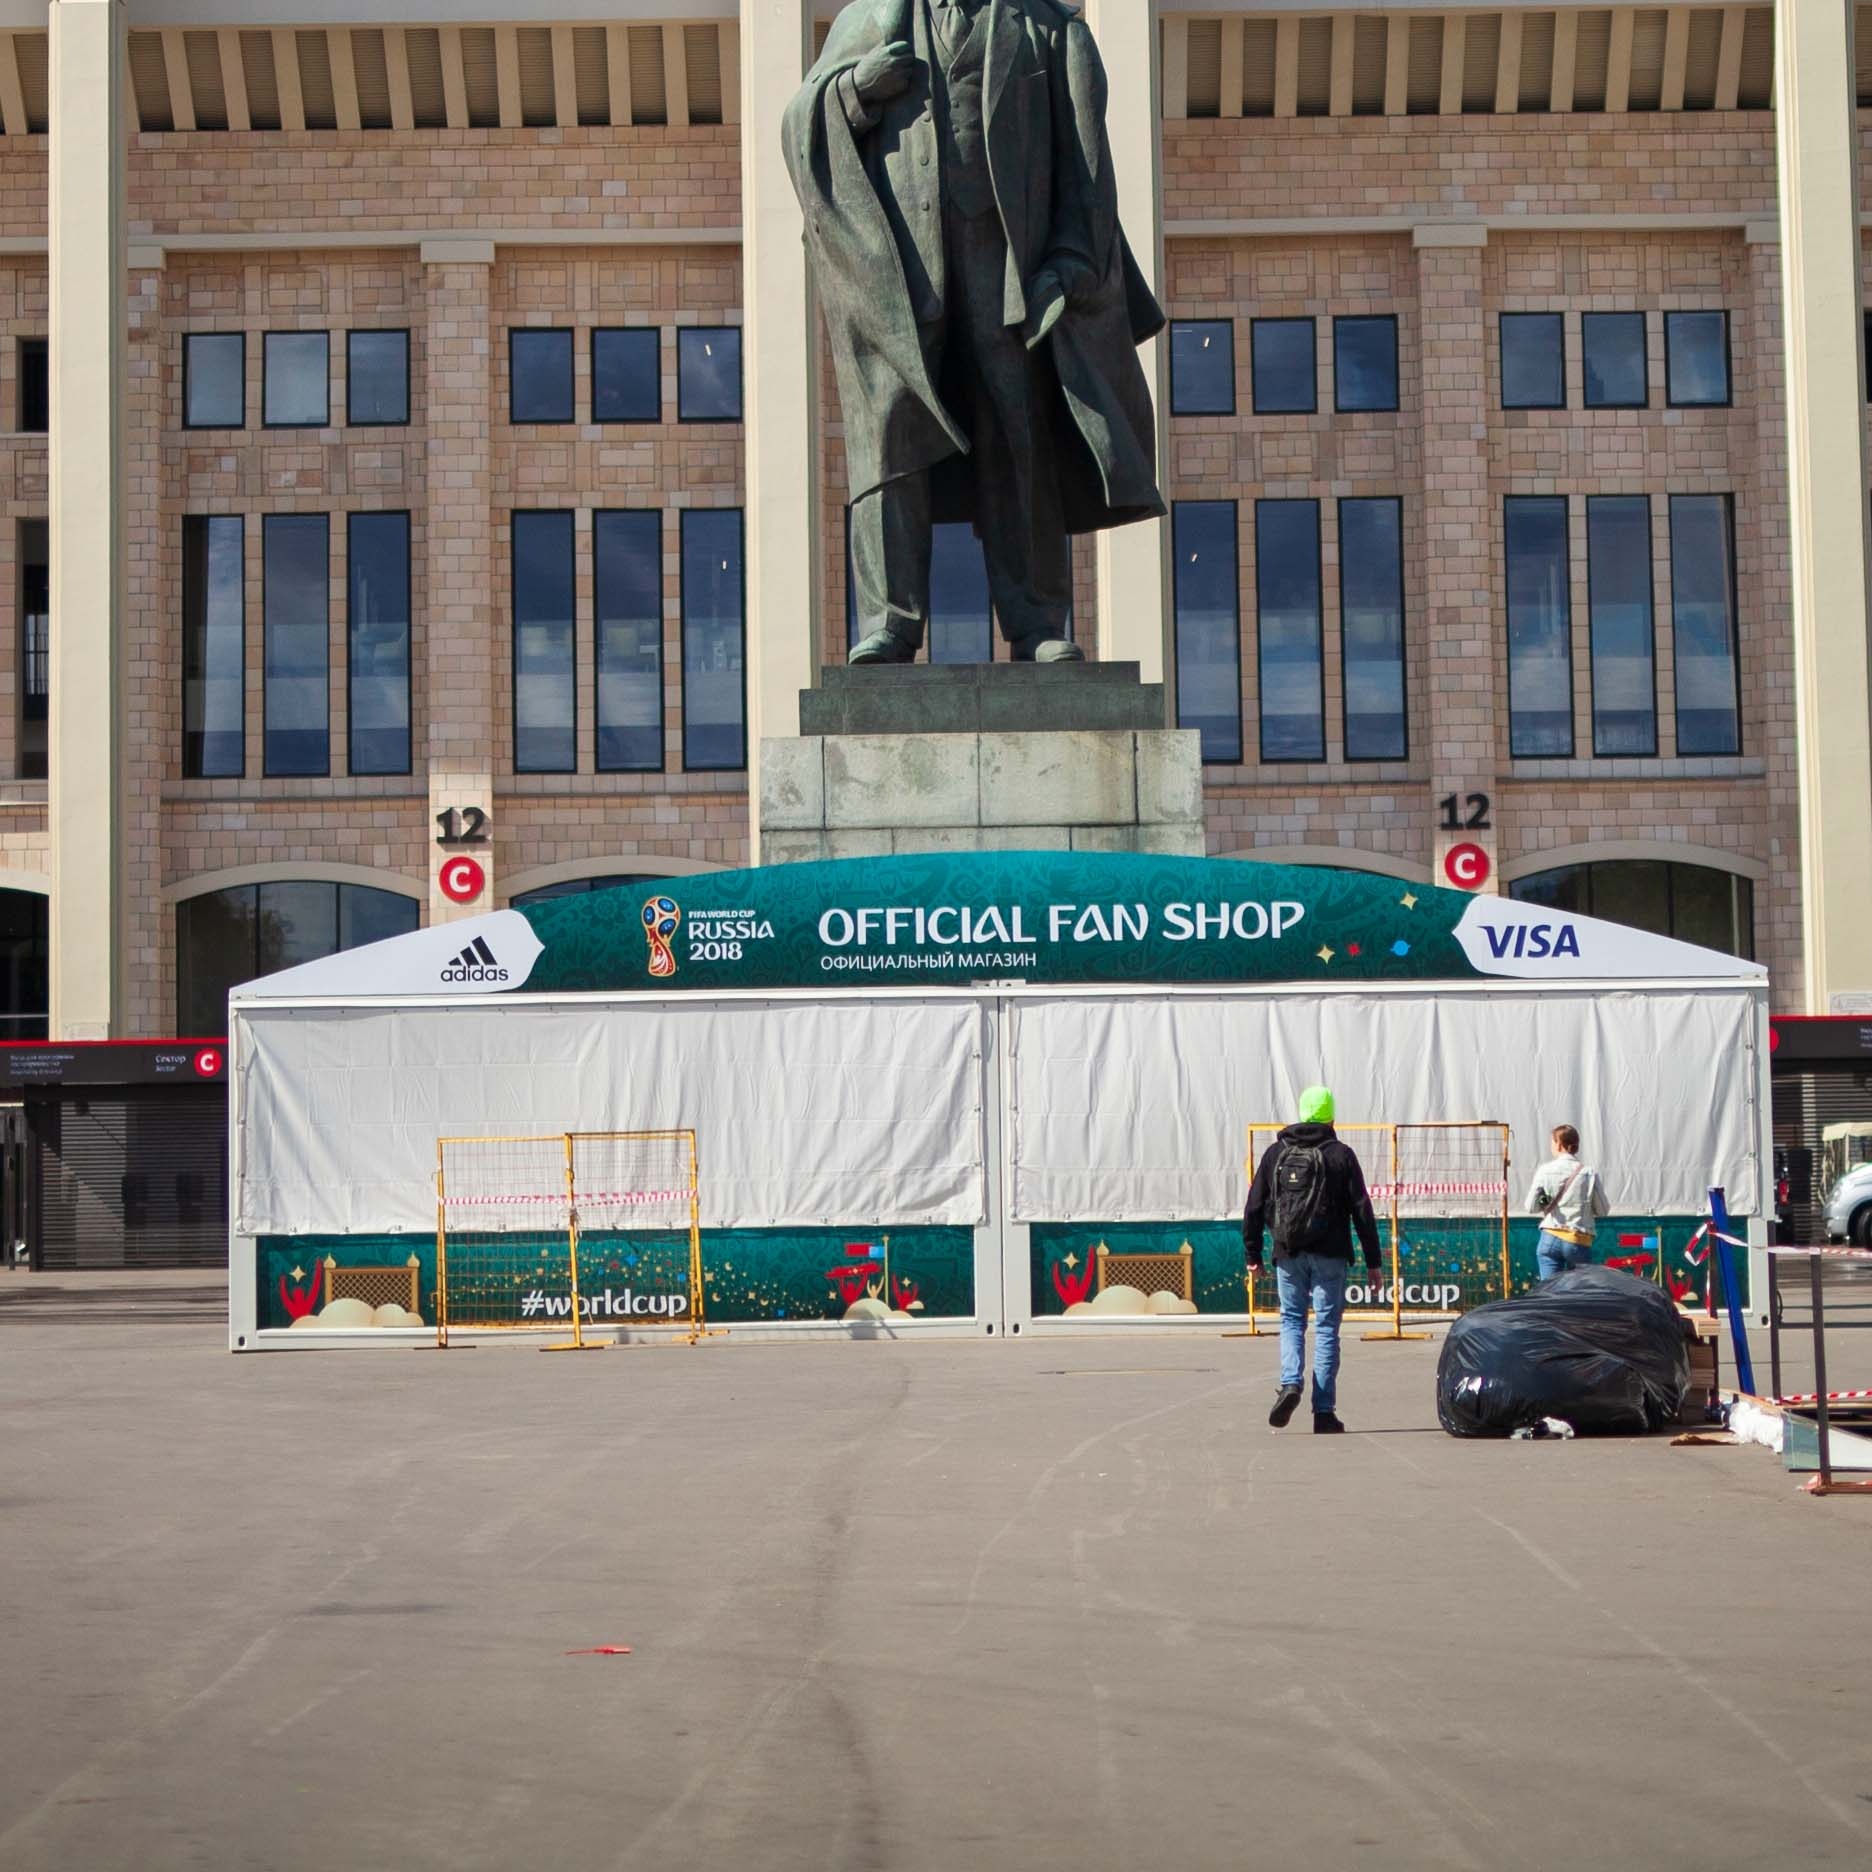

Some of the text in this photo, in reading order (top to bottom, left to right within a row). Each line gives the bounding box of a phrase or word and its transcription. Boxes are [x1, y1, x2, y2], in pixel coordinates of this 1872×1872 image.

[1440, 793, 1491, 830] 12
[437, 807, 486, 844] 12
[688, 910, 756, 919] FIFA WORLD CUP
[818, 901, 1306, 946] OFFICIAL FAN SHOP
[688, 921, 775, 940] RUSSIA
[1477, 924, 1580, 958] VISA
[689, 942, 743, 961] 2018
[821, 951, 1037, 972] ОФИЦИАЛЬНЫЙ МАГАЗИН
[440, 965, 508, 982] adidas
[155, 1055, 186, 1065] Сектор
[522, 1288, 688, 1317] #worldcup
